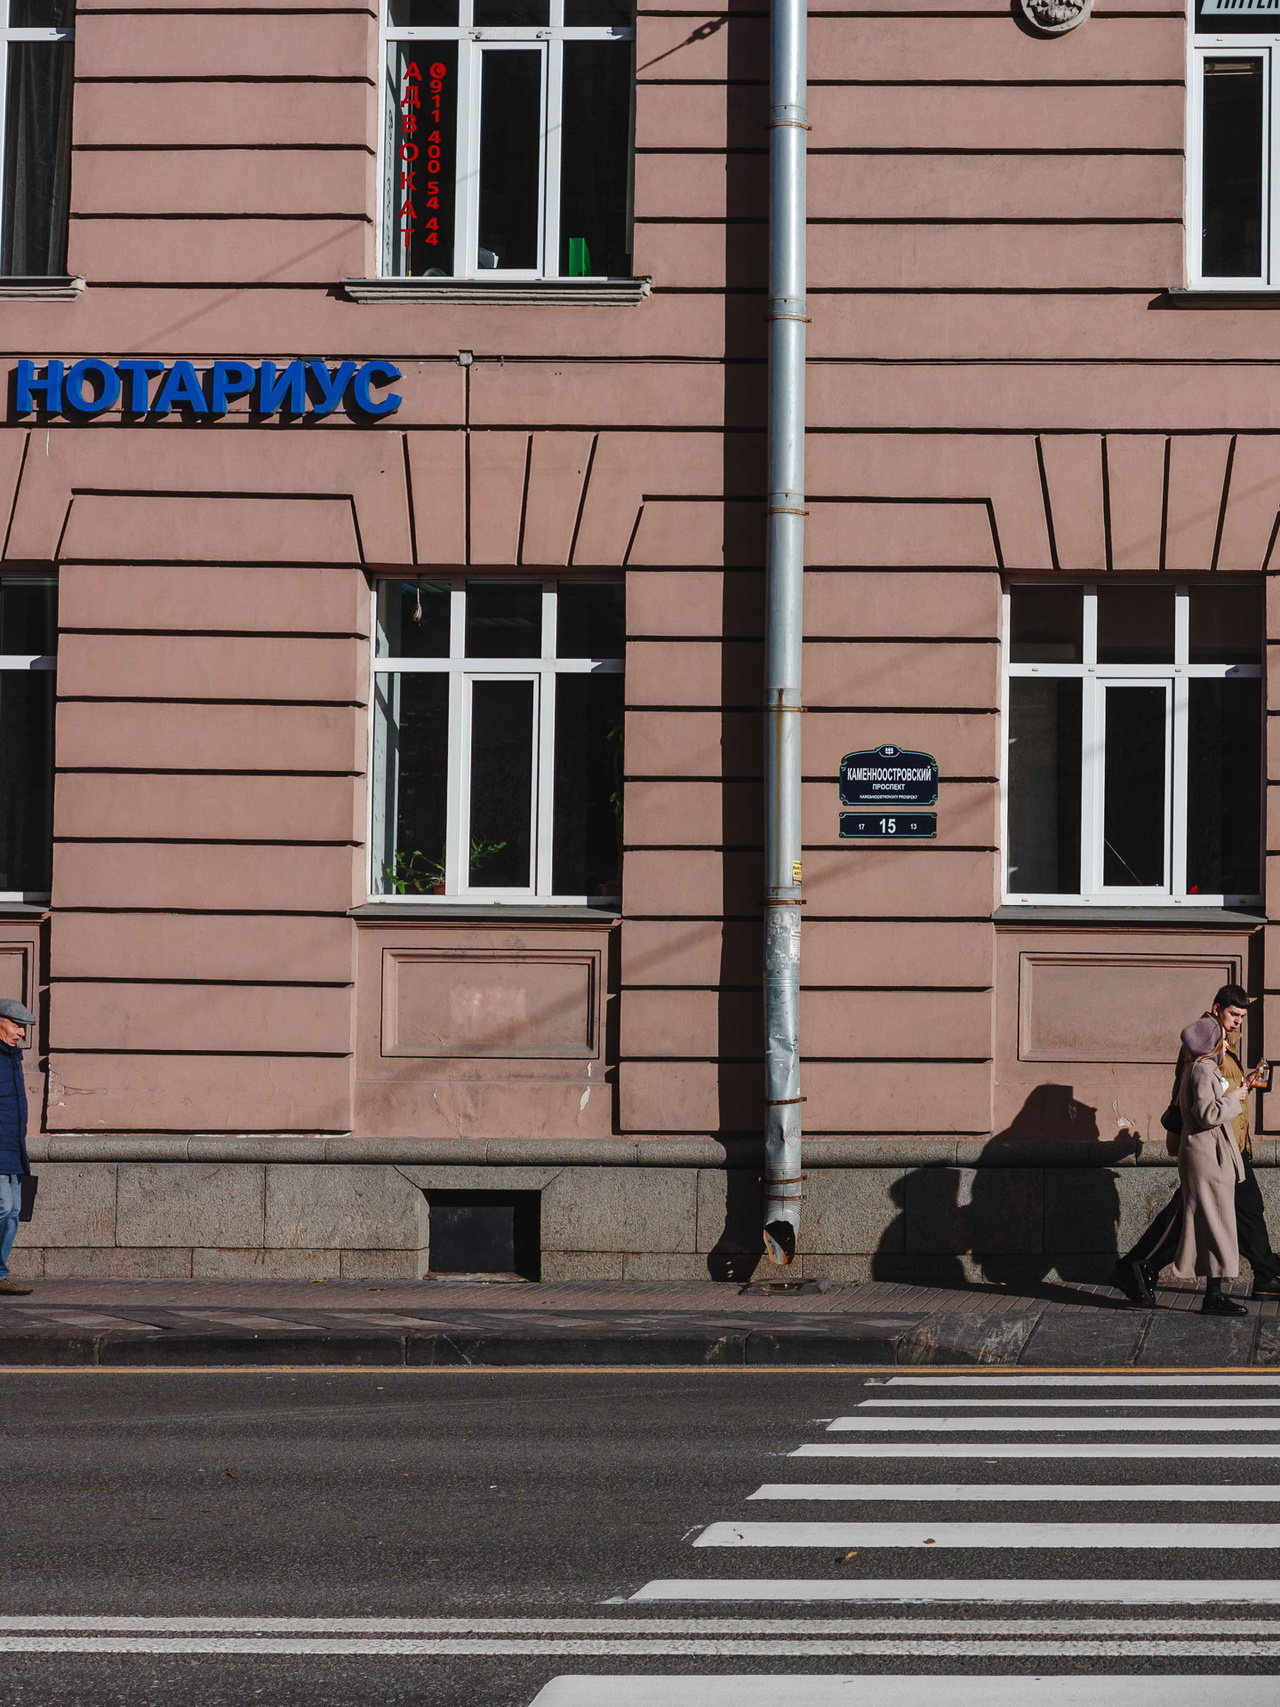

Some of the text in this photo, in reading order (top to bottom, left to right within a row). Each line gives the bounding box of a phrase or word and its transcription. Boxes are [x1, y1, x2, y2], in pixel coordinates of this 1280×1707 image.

[429, 80, 443, 123] 911
[398, 62, 422, 247] АДВОКАТ
[428, 130, 441, 174] 400
[16, 358, 403, 414] НОТАРИУС
[847, 766, 932, 781] КАМЕННООСТРОВСКИЙ
[879, 818, 897, 834] 15
